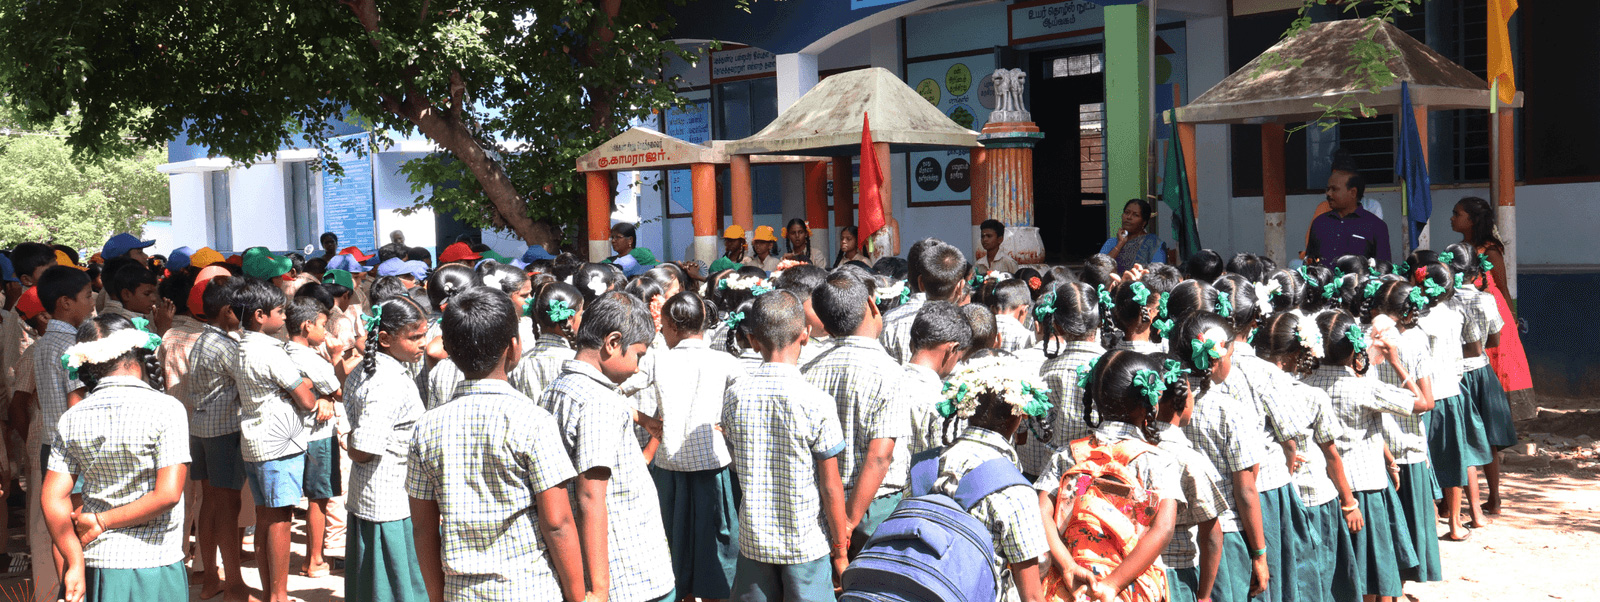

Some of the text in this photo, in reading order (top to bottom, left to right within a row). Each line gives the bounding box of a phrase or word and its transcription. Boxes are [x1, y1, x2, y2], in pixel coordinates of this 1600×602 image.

[1028, 6, 1047, 20] உயர்
[1048, 1, 1075, 17] தொழில்
[1042, 14, 1076, 28] ஆய்வகம்
